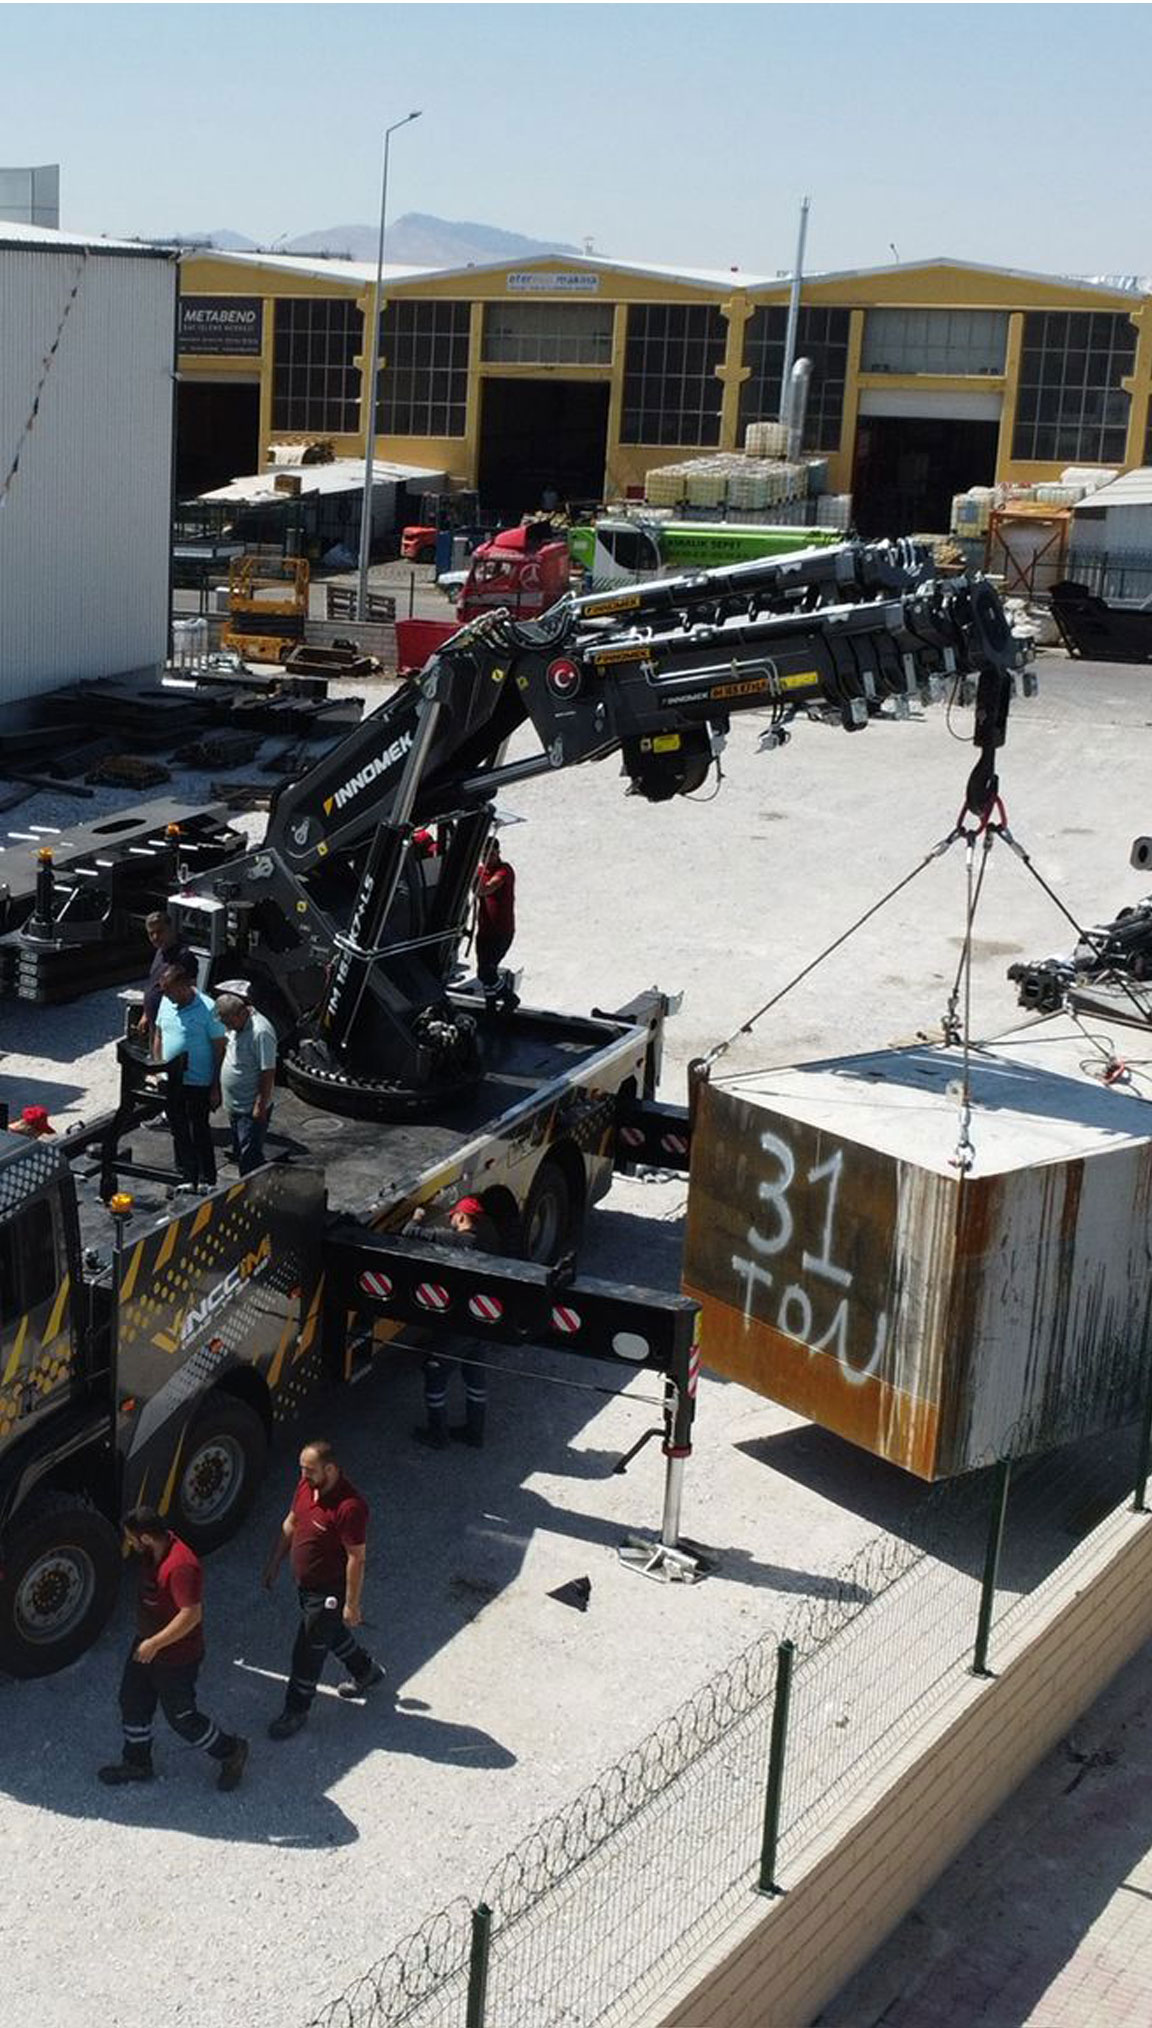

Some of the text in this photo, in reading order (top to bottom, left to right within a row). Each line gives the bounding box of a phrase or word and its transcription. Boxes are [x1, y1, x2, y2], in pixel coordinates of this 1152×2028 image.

[184, 309, 257, 323] METABEND
[334, 730, 413, 809] INNOMEK
[747, 1132, 853, 1288] 31
